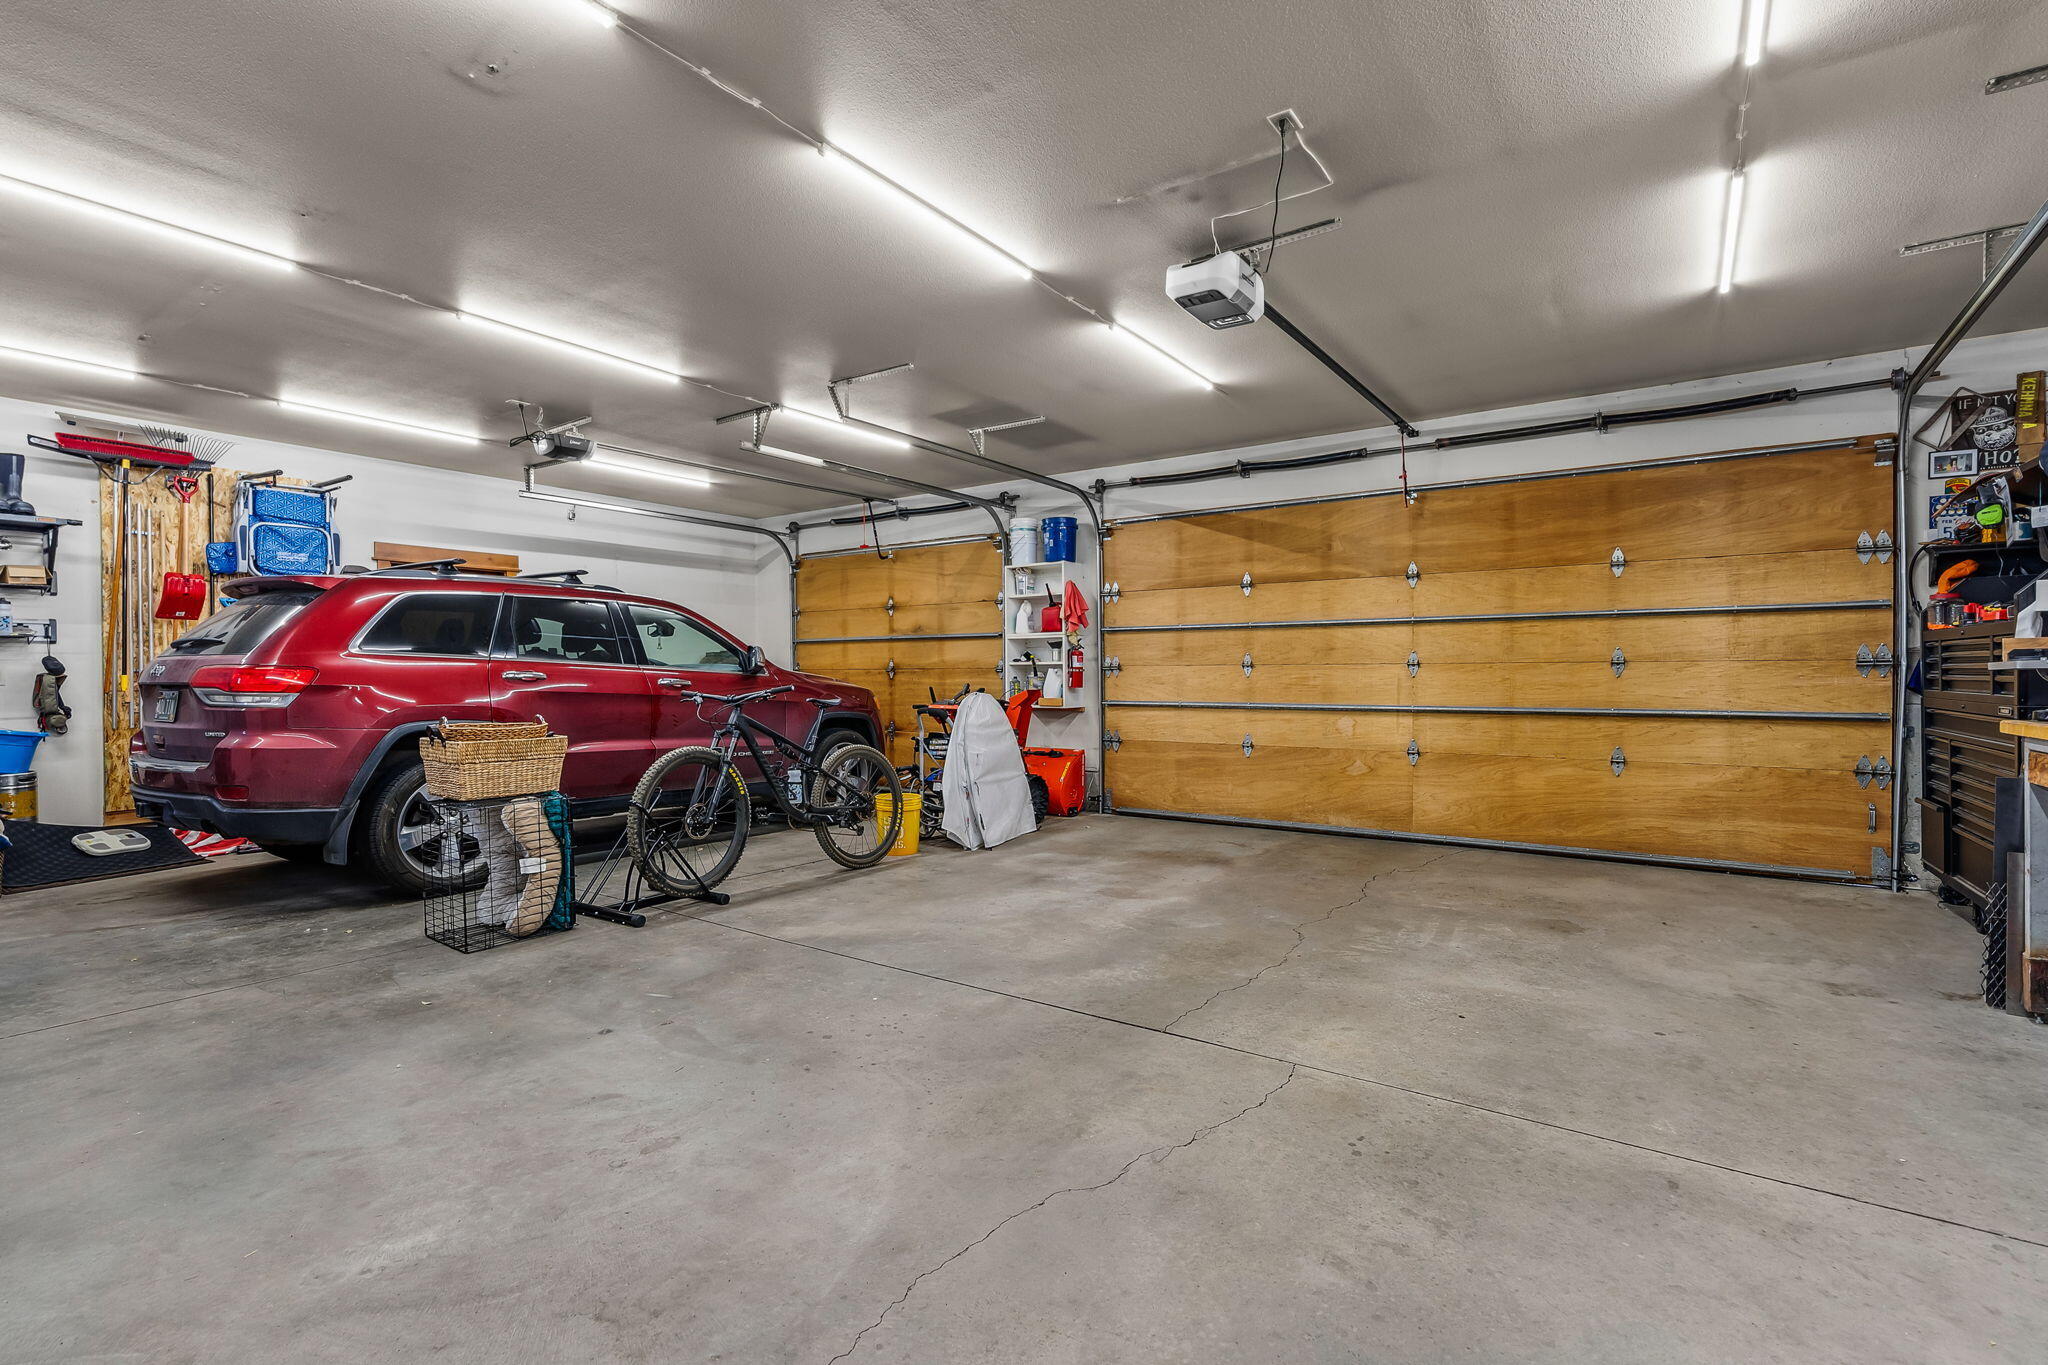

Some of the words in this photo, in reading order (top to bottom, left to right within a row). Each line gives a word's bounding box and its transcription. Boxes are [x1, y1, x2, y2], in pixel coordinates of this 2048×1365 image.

[1959, 398, 1972, 410] IF
[1977, 395, 2001, 407] NT
[728, 767, 746, 796] MAXXIS
